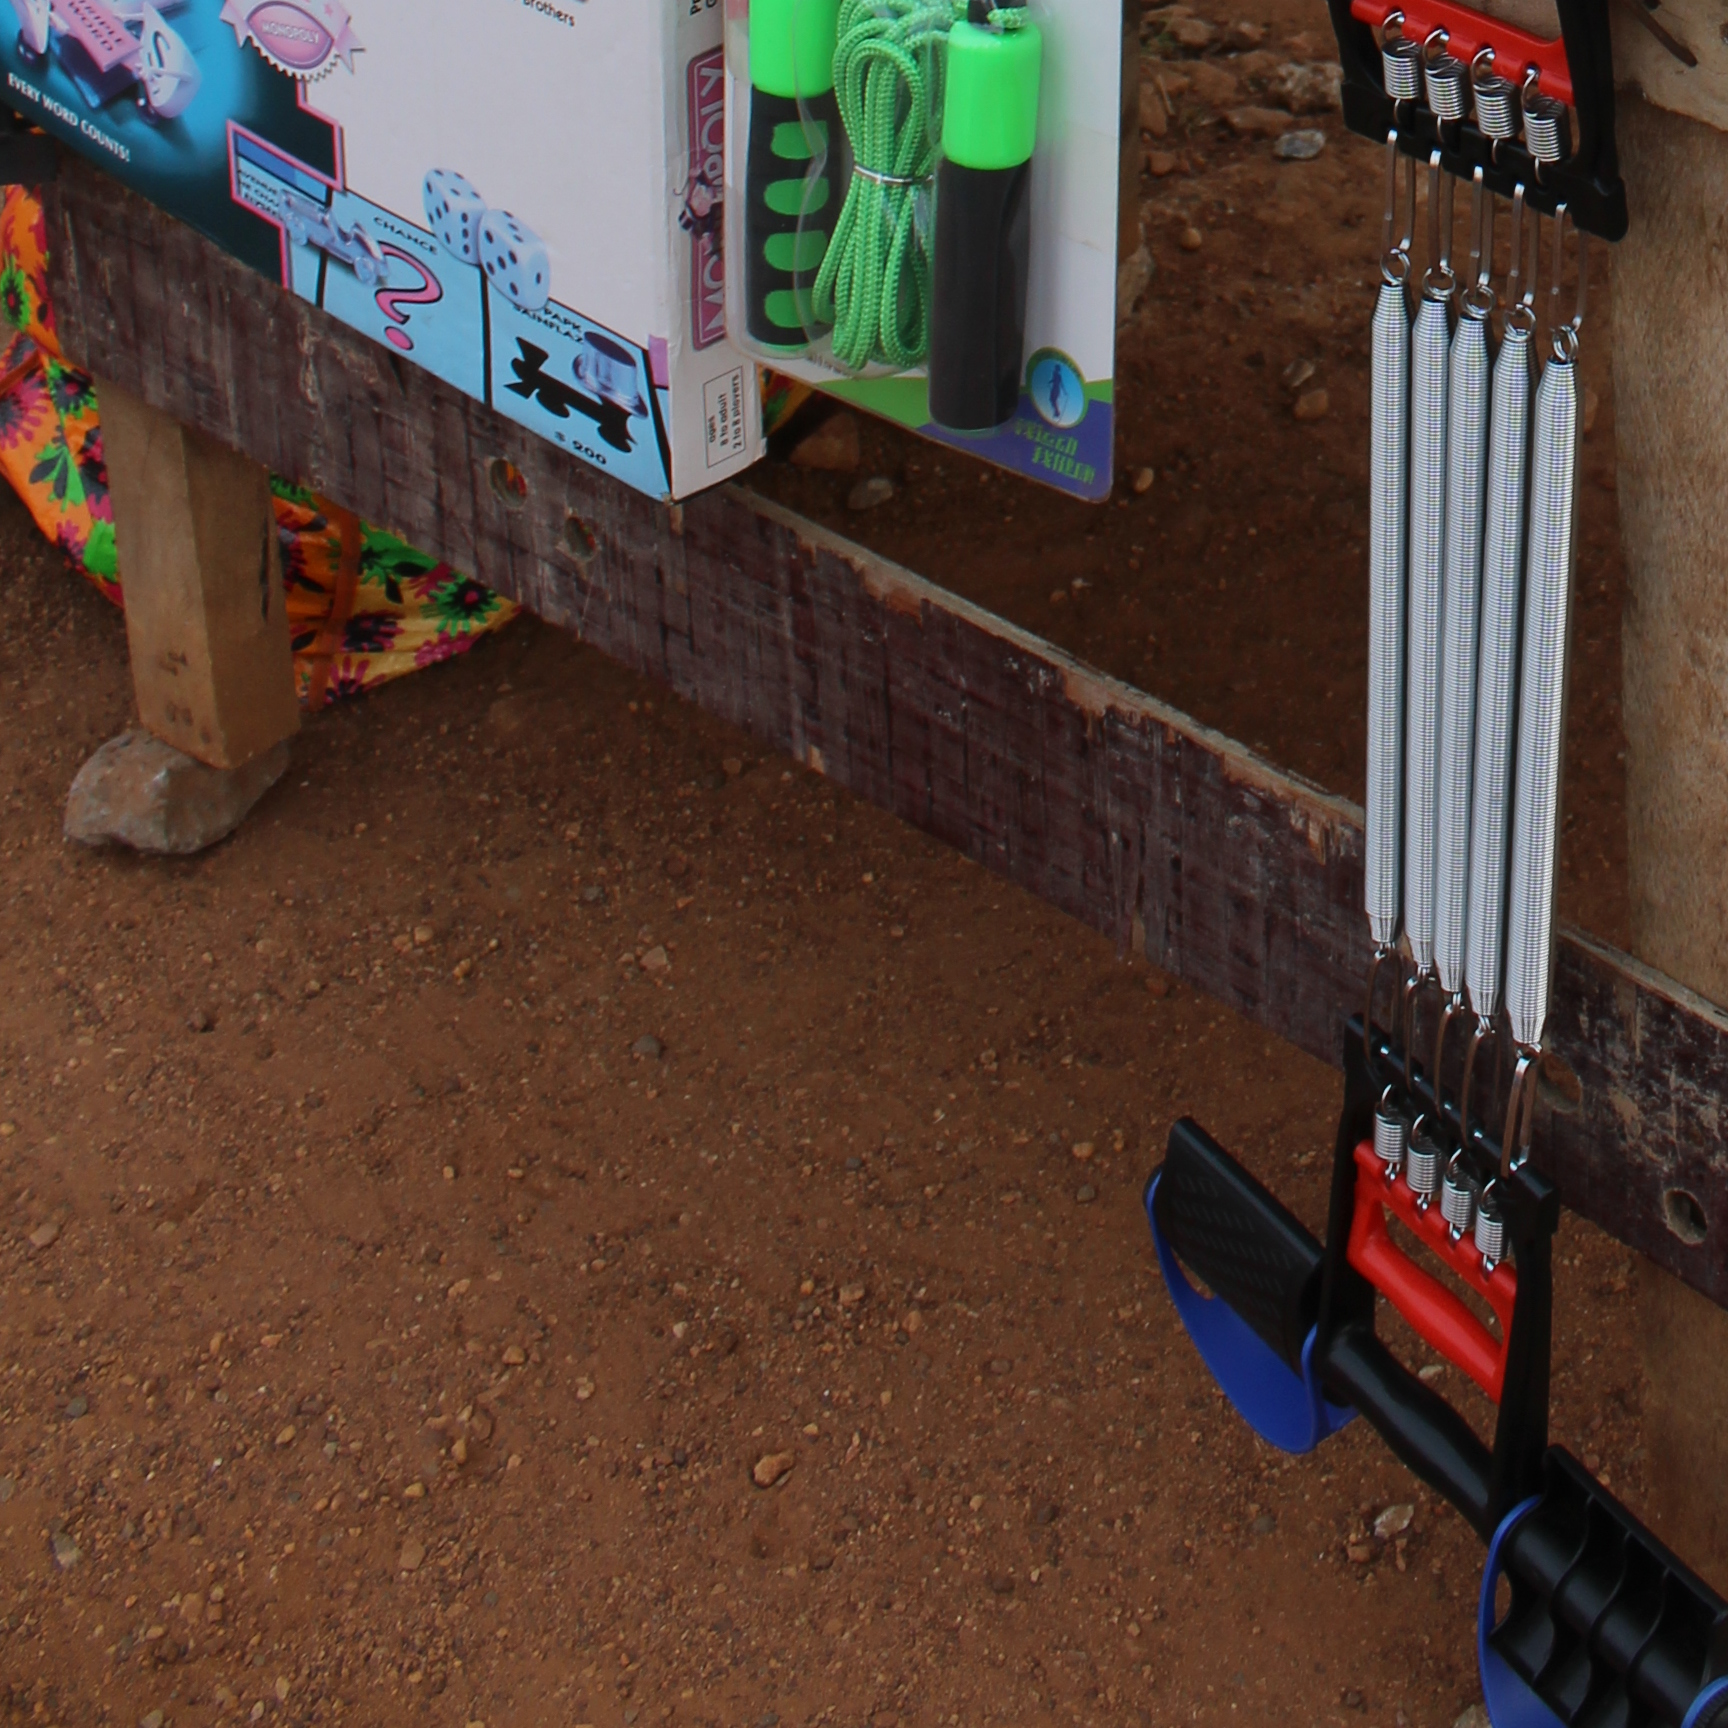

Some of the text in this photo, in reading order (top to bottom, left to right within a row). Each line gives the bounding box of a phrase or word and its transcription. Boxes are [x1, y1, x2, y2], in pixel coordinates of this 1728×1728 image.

[7, 72, 131, 163] EVERY WORD COUNTS!
[374, 216, 439, 255] CHANCE
[718, 392, 728, 423] adult
[732, 374, 741, 417] players
[573, 439, 607, 466] 200
